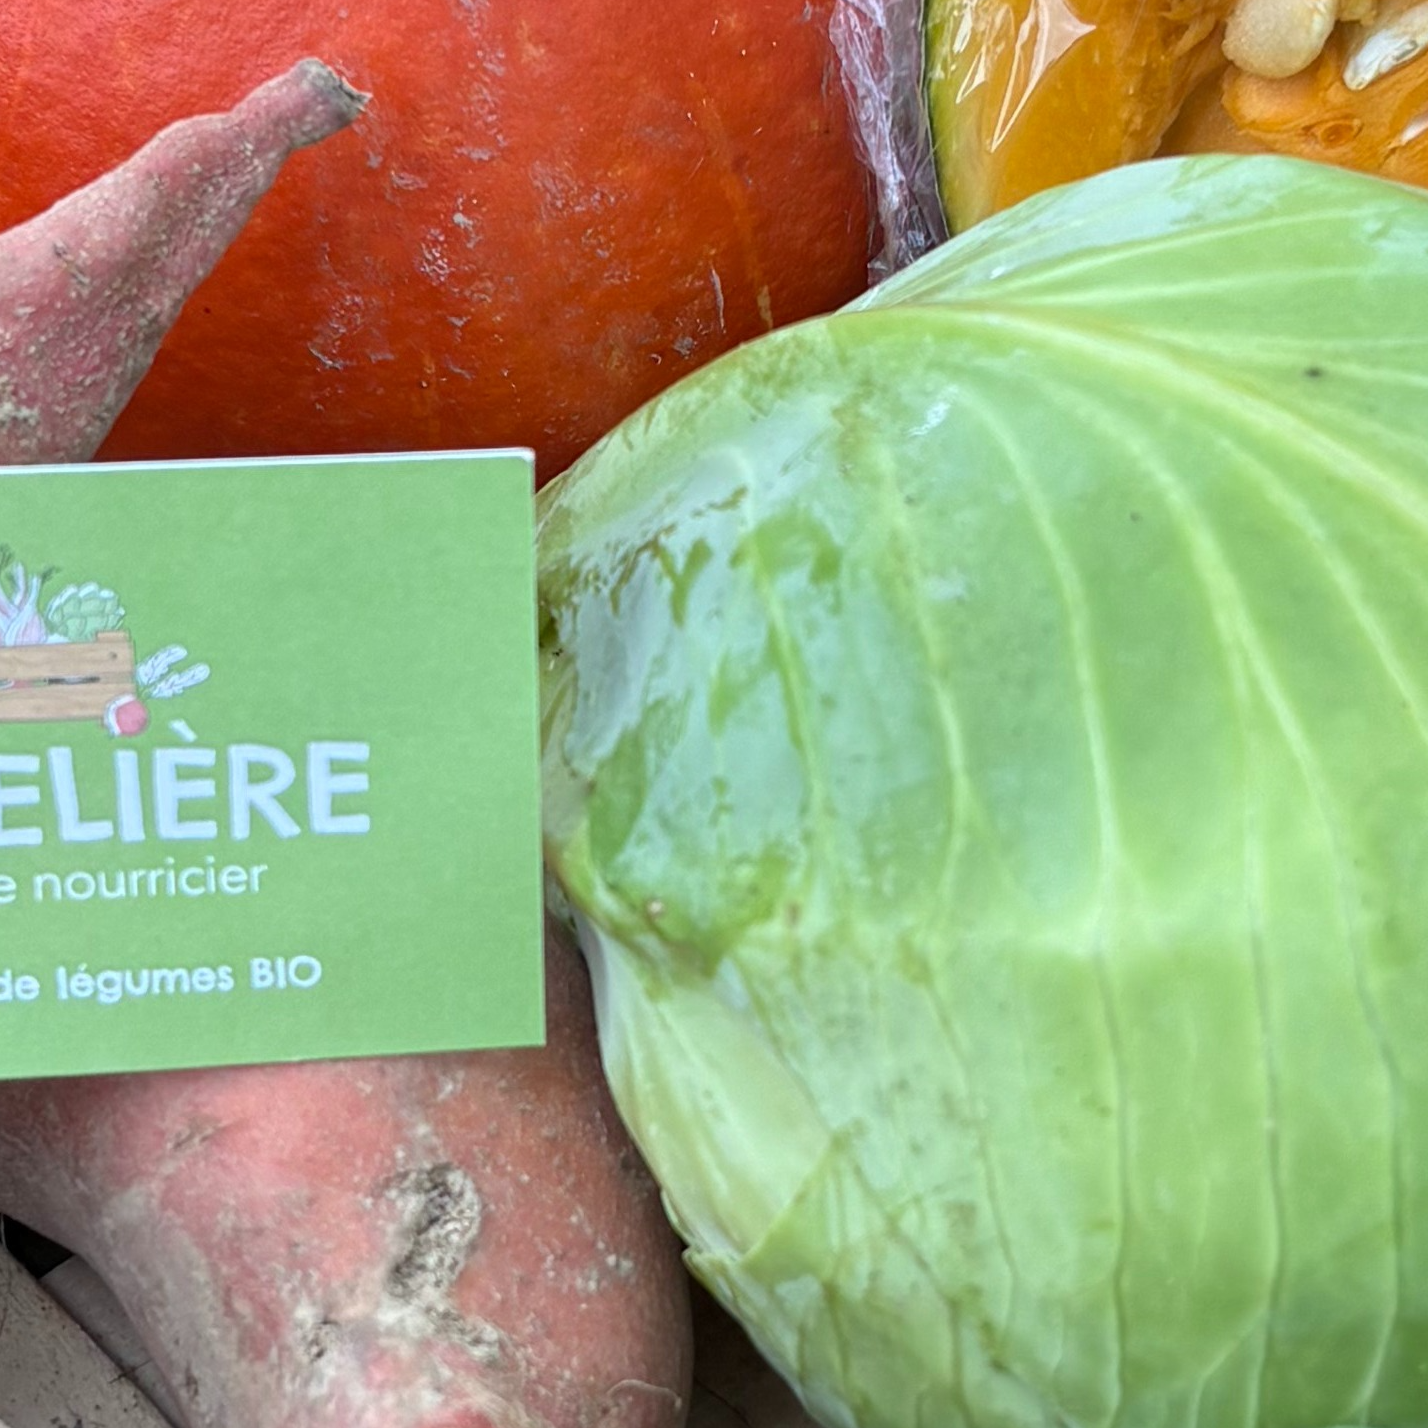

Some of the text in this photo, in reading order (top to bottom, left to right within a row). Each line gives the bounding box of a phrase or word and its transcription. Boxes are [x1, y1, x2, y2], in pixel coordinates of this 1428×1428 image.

[32, 857, 269, 903] nourricier
[56, 964, 236, 1005] légumes
[249, 954, 324, 989] BIO
